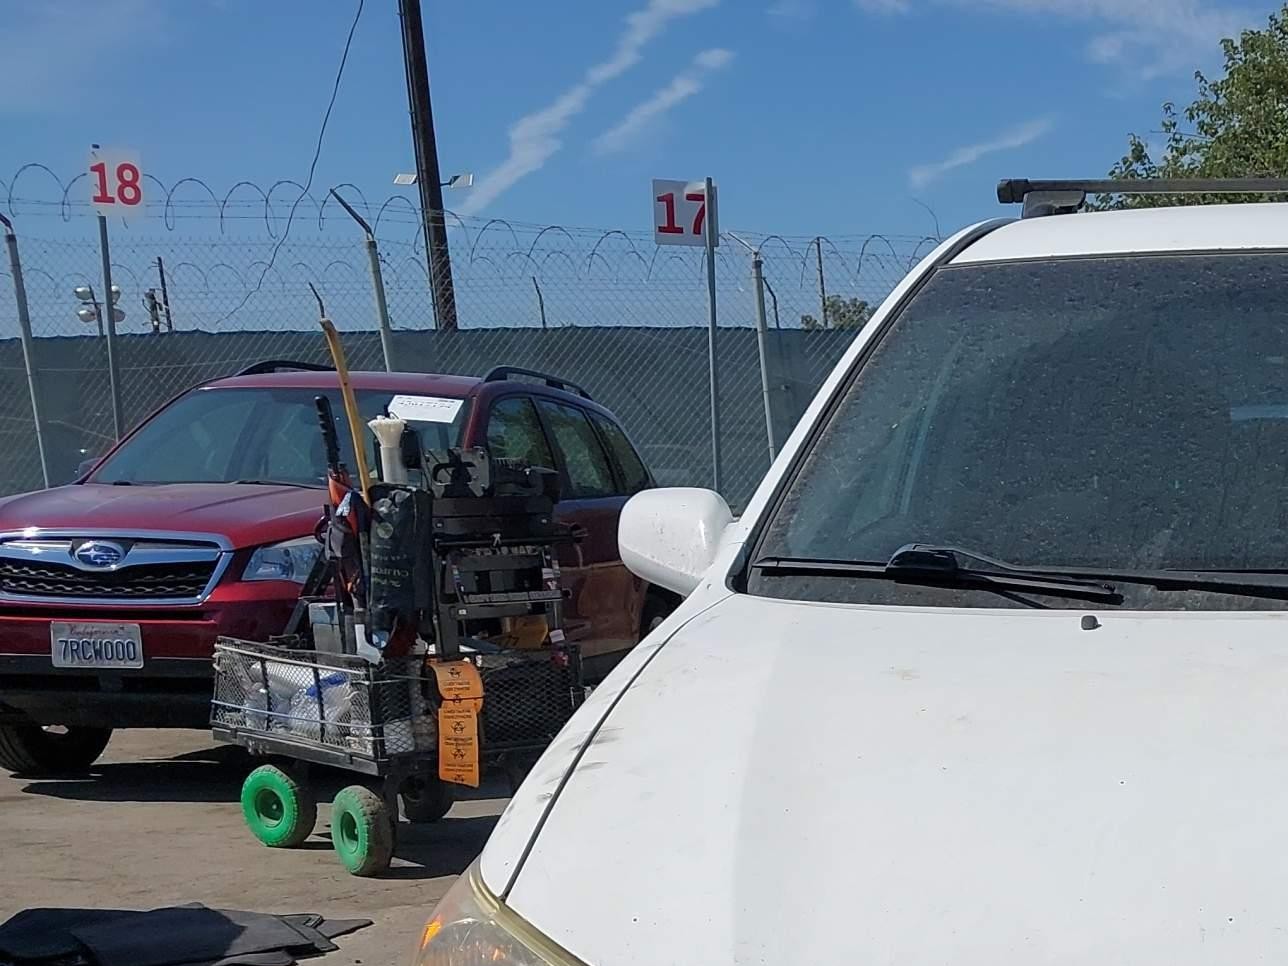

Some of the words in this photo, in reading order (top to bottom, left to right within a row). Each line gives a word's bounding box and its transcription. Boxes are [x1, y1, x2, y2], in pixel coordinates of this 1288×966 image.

[89, 162, 142, 206] 18
[656, 192, 706, 236] 17
[58, 639, 137, 661] 7RCW000
